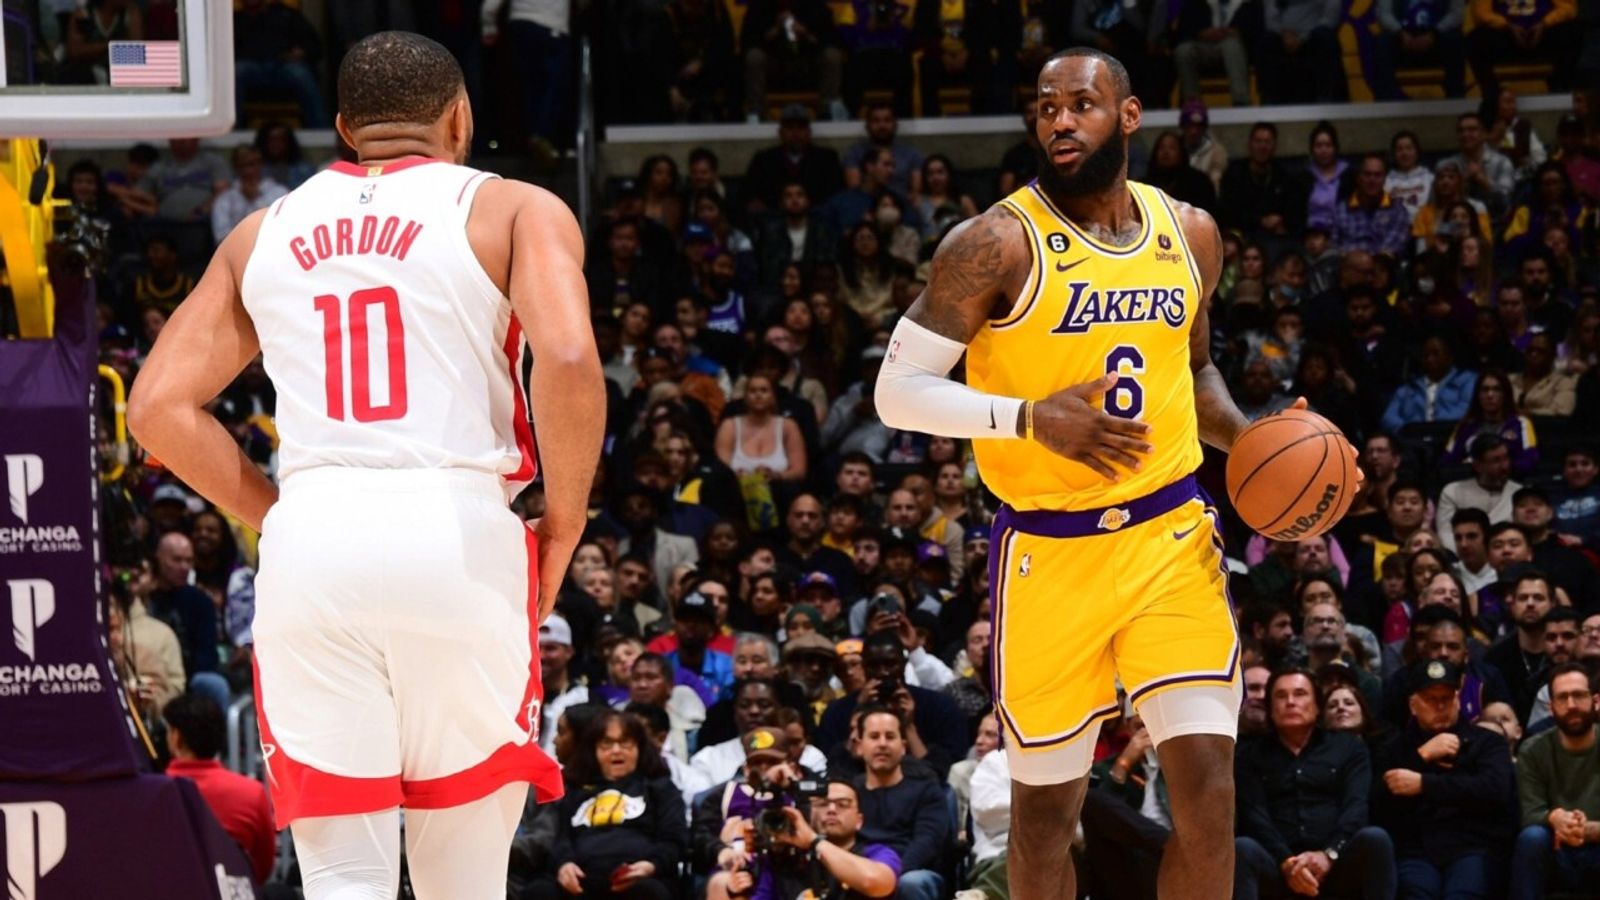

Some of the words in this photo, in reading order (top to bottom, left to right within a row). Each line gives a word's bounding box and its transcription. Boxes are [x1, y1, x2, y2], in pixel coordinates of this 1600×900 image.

[289, 215, 423, 271] GORDON
[1051, 235, 1065, 250] 6
[1155, 251, 1182, 264] bibigo
[1051, 282, 1187, 334] LAKERS
[313, 286, 408, 423] 10
[1104, 344, 1145, 420] 6
[1268, 483, 1339, 540] Wilson
[32, 541, 82, 552] CASINO
[40, 680, 102, 694] CASINO
